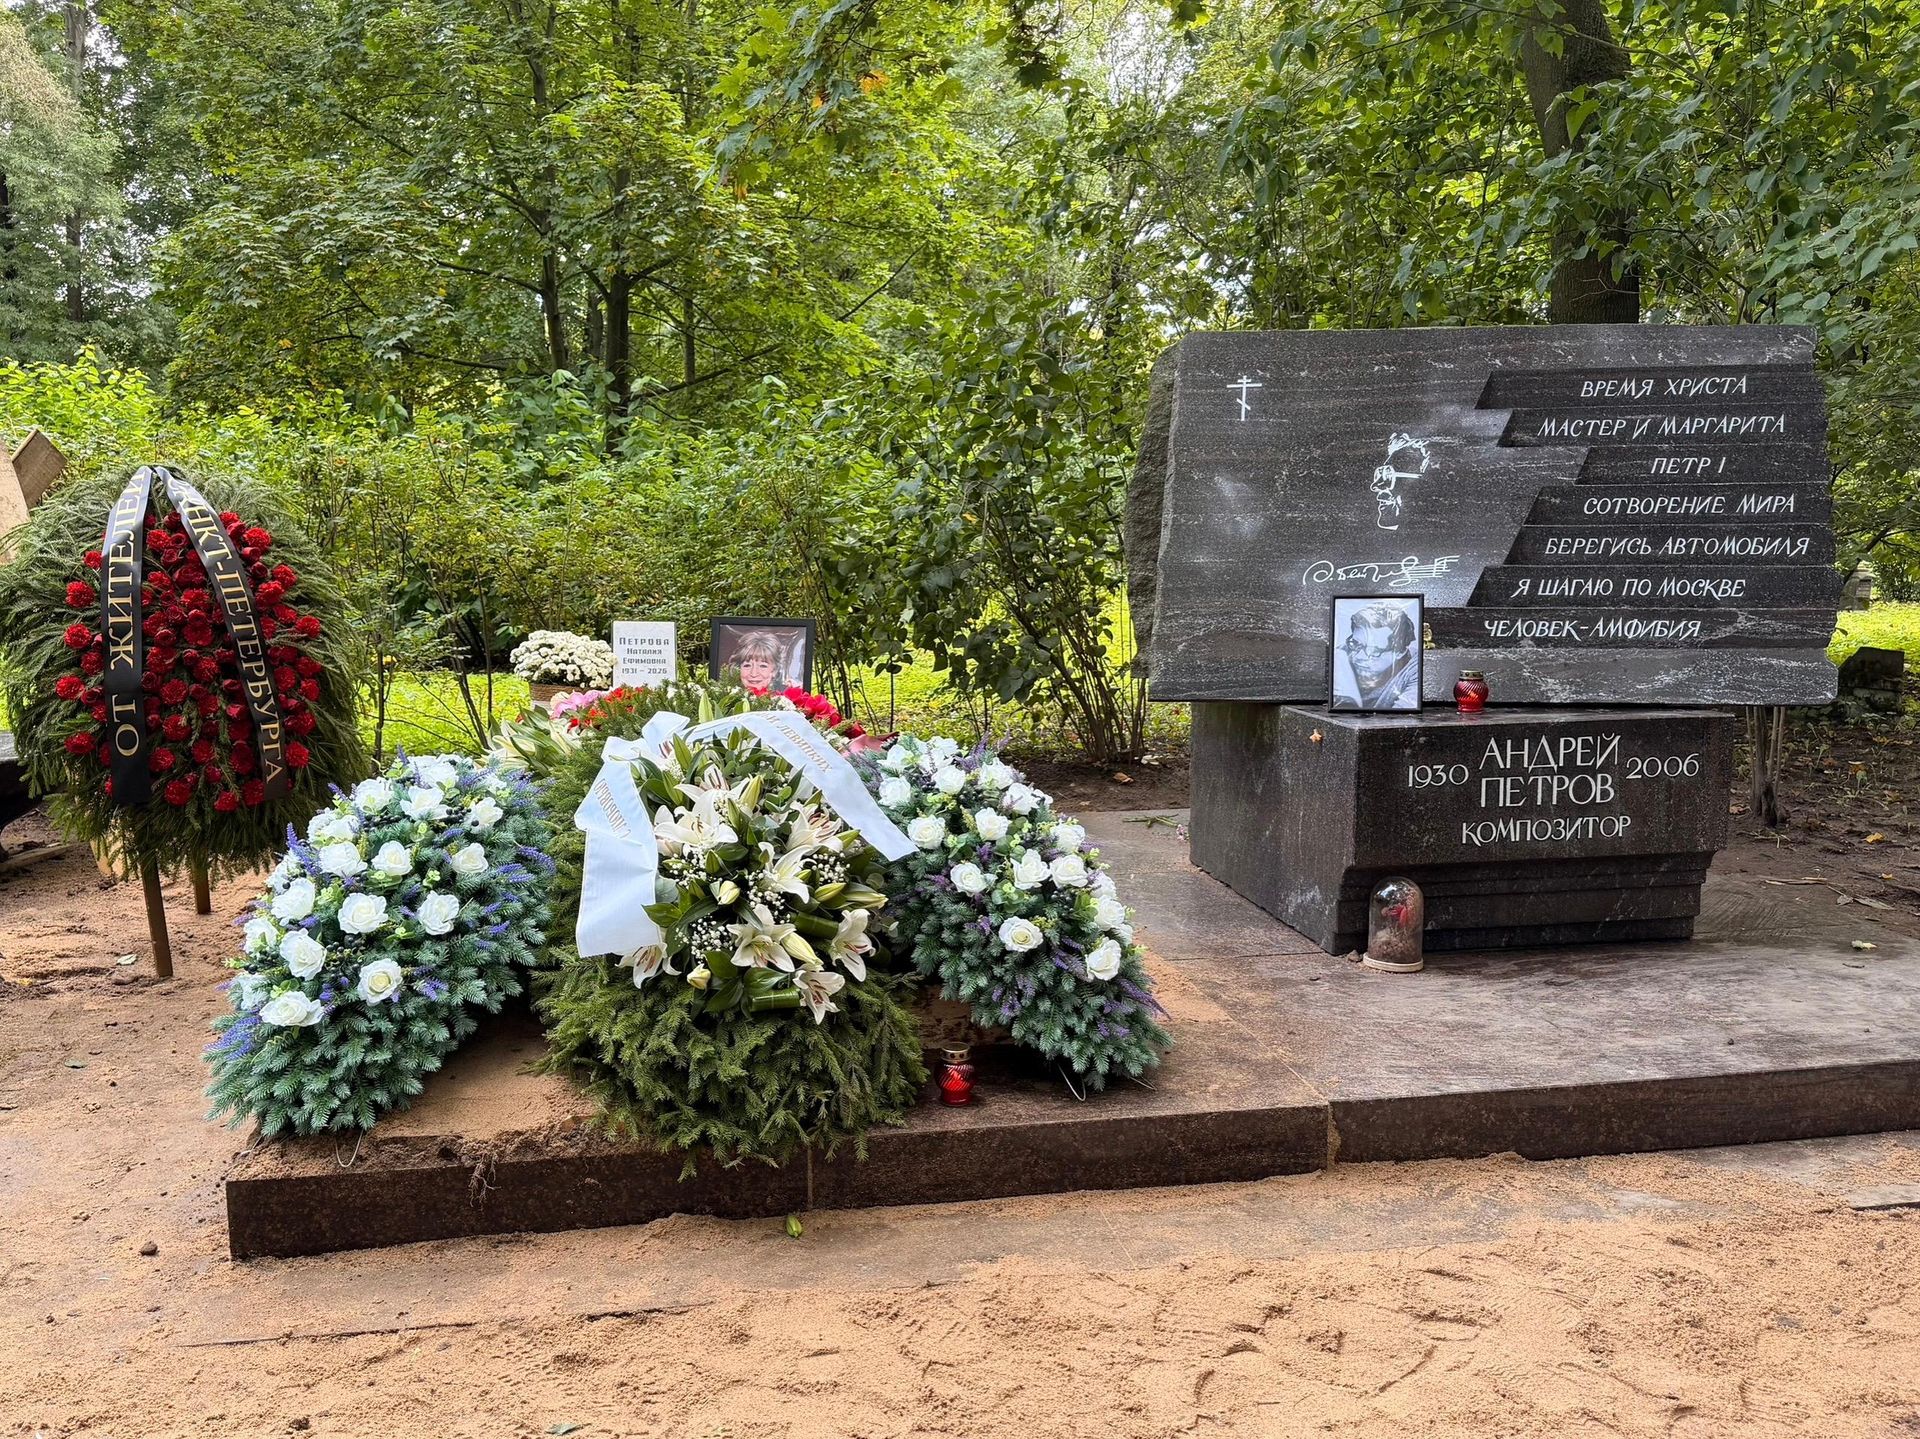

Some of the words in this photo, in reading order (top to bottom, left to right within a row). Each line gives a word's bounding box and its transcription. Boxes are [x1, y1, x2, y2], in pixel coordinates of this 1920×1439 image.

[1580, 378, 1654, 398] ВРЕМЯ
[1664, 375, 1747, 396] ХРИСТА
[1538, 418, 1627, 437] МАСТЕР
[1632, 418, 1651, 440] И
[1658, 414, 1786, 435] МАРГАРИТА
[1651, 457, 1711, 474] ПЕТР
[1583, 496, 1726, 515] СОТВОРЕНИЕ
[1736, 493, 1795, 514] МИРА
[1544, 537, 1652, 556] БЕРЕГИСЬ
[1659, 536, 1810, 556] АВТОМОБИЛЯ
[1510, 580, 1529, 598] Я
[1538, 578, 1613, 596] ШАГАЮ
[1622, 579, 1652, 595] ПО
[1656, 578, 1746, 599] МОСКВЕ
[167, 478, 283, 784] САНКТ-ПЕТЕРБУРГА
[1484, 618, 1701, 641] ЧЕЛОВЕК-АМФИБИЯ
[111, 693, 139, 757] ОТ
[1479, 733, 1621, 774] АНДРЕЙ
[1625, 753, 1700, 780] 2006
[1408, 763, 1469, 789] 1930
[1480, 774, 1615, 808] ПЕТРОВ
[1461, 815, 1632, 847] КОМПОЗИТОР
